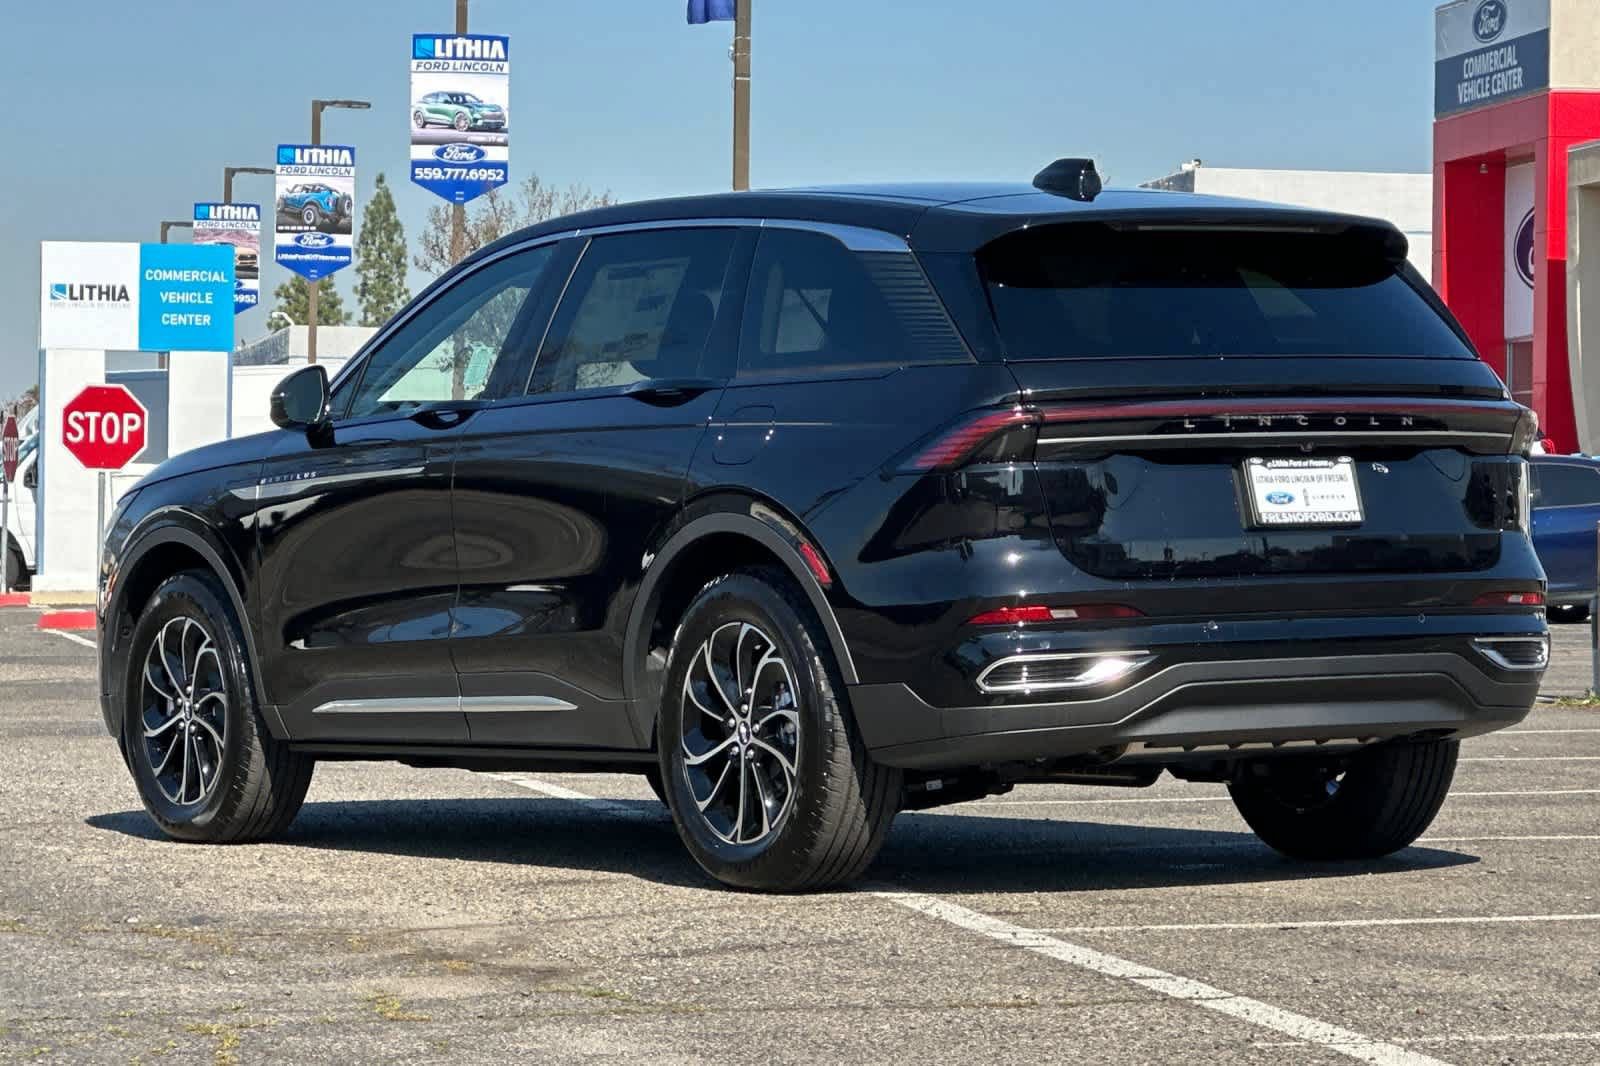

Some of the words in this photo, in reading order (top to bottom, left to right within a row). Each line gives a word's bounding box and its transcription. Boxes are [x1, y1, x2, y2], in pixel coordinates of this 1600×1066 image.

[1478, 5, 1500, 36] Ford
[435, 38, 505, 59] LITHIA
[415, 61, 450, 71] FORD
[453, 62, 504, 72] LINCOLN
[1463, 45, 1518, 79] COMMERCIAL
[1457, 75, 1490, 104] VEHICLE
[1491, 67, 1523, 95] CENTER
[295, 148, 353, 165] LITHIA
[443, 146, 477, 161] Ford
[279, 166, 307, 174] FORD
[309, 167, 351, 175] LINCOLN
[414, 167, 504, 182] 559.777.6952
[208, 206, 259, 220] LITHIA
[145, 269, 229, 283] COMMERCIAL
[68, 283, 130, 302] LITHIA
[159, 291, 213, 304] VEHICLE
[161, 313, 212, 326] CENTER
[66, 410, 142, 445] STOP
[1183, 414, 1414, 429] LINCOLN
